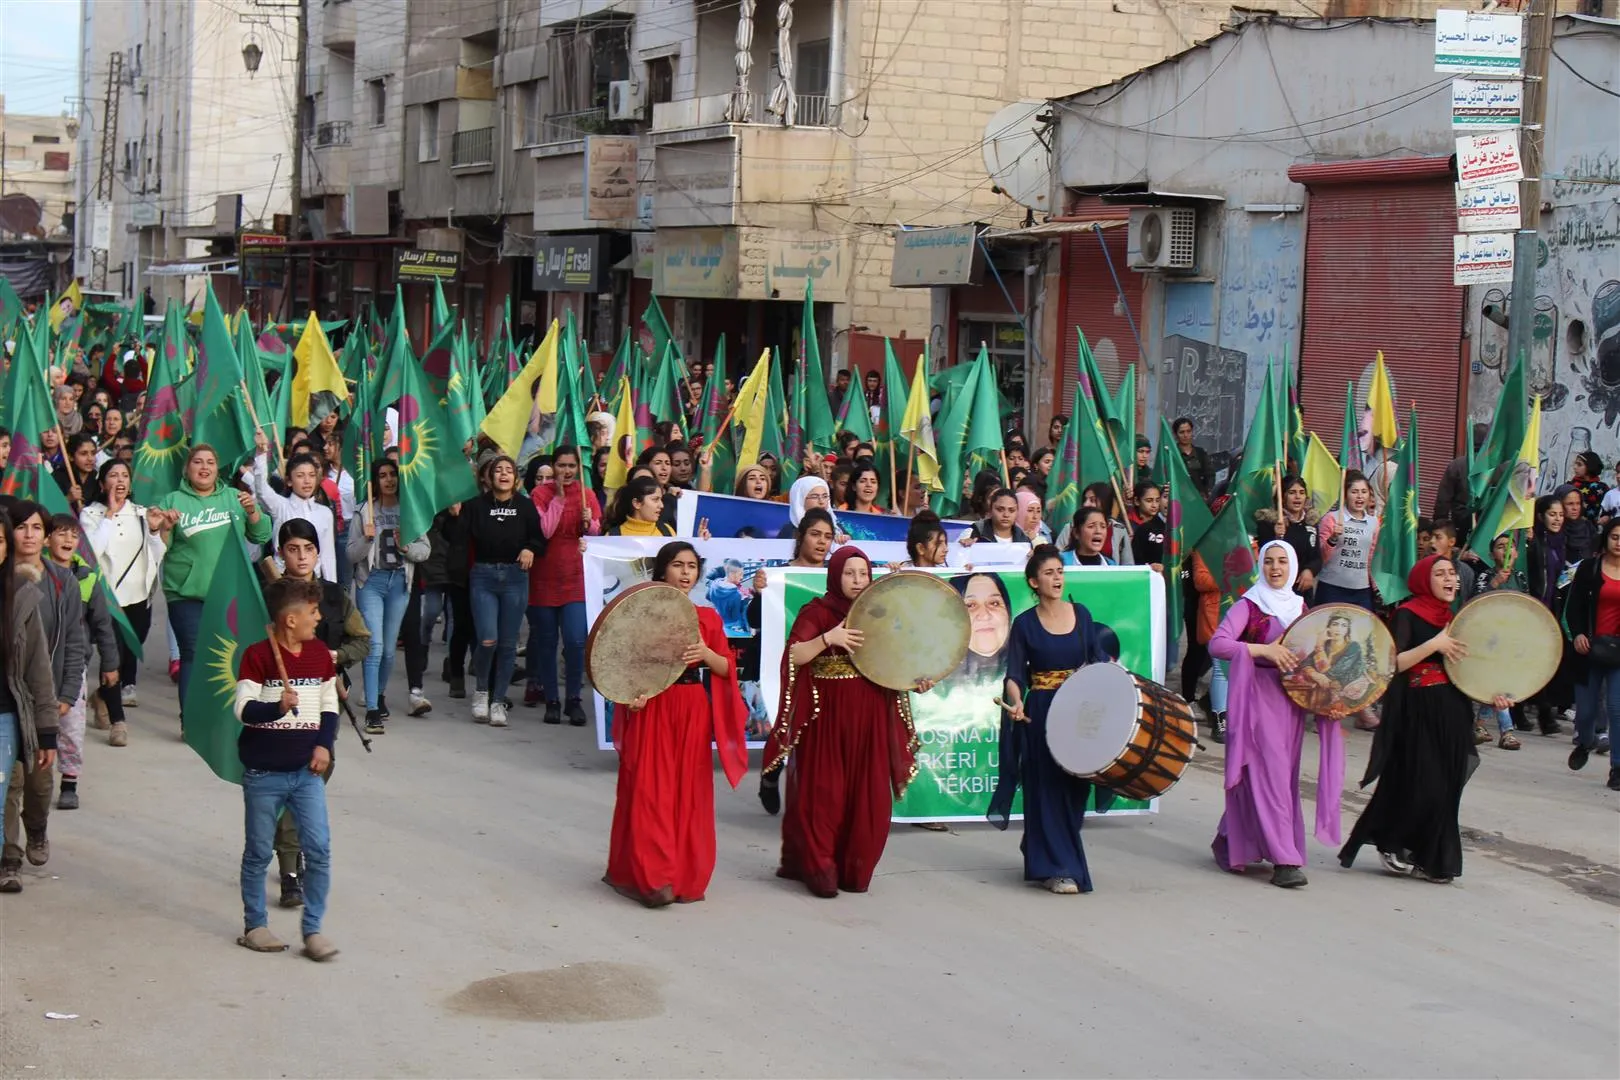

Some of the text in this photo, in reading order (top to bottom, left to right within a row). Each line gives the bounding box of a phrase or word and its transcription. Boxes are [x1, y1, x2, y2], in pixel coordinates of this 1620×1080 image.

[1437, 31, 1470, 44] الحسين
[1497, 33, 1518, 46] جمال
[1472, 83, 1503, 92] الدكتور
[1472, 136, 1500, 149] الدكتورة
[1462, 145, 1514, 169] شيرين فرمان
[1489, 191, 1517, 206] رياض
[1343, 537, 1358, 547] FOR
